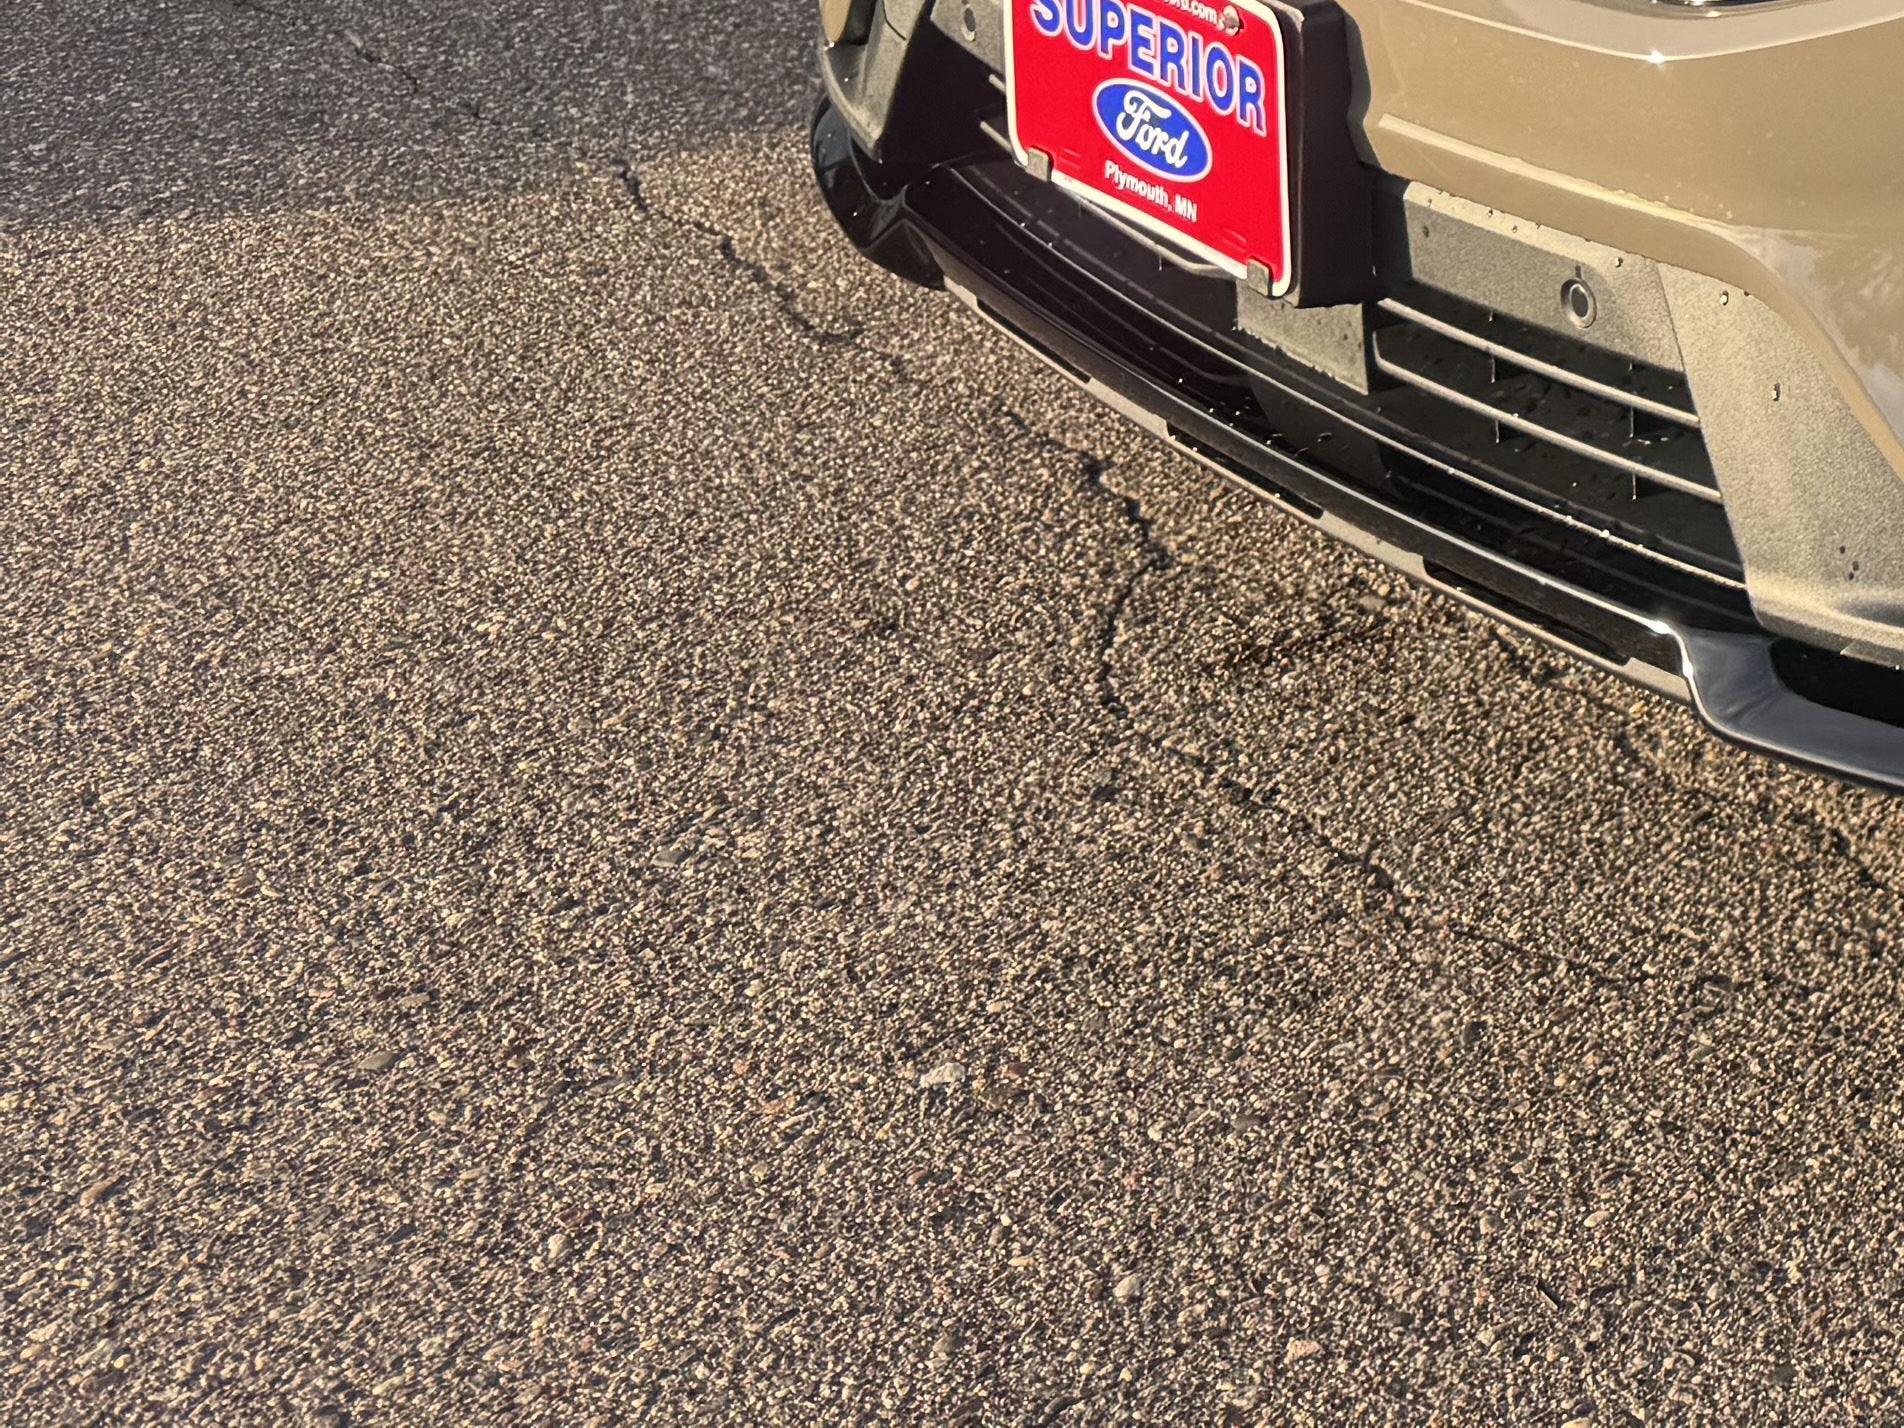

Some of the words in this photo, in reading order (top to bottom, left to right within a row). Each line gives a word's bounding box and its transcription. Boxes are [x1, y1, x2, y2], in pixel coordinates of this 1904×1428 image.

[1116, 89, 1189, 169] Ford
[1104, 160, 1173, 212] Plymouth,
[1174, 192, 1199, 223] MN
